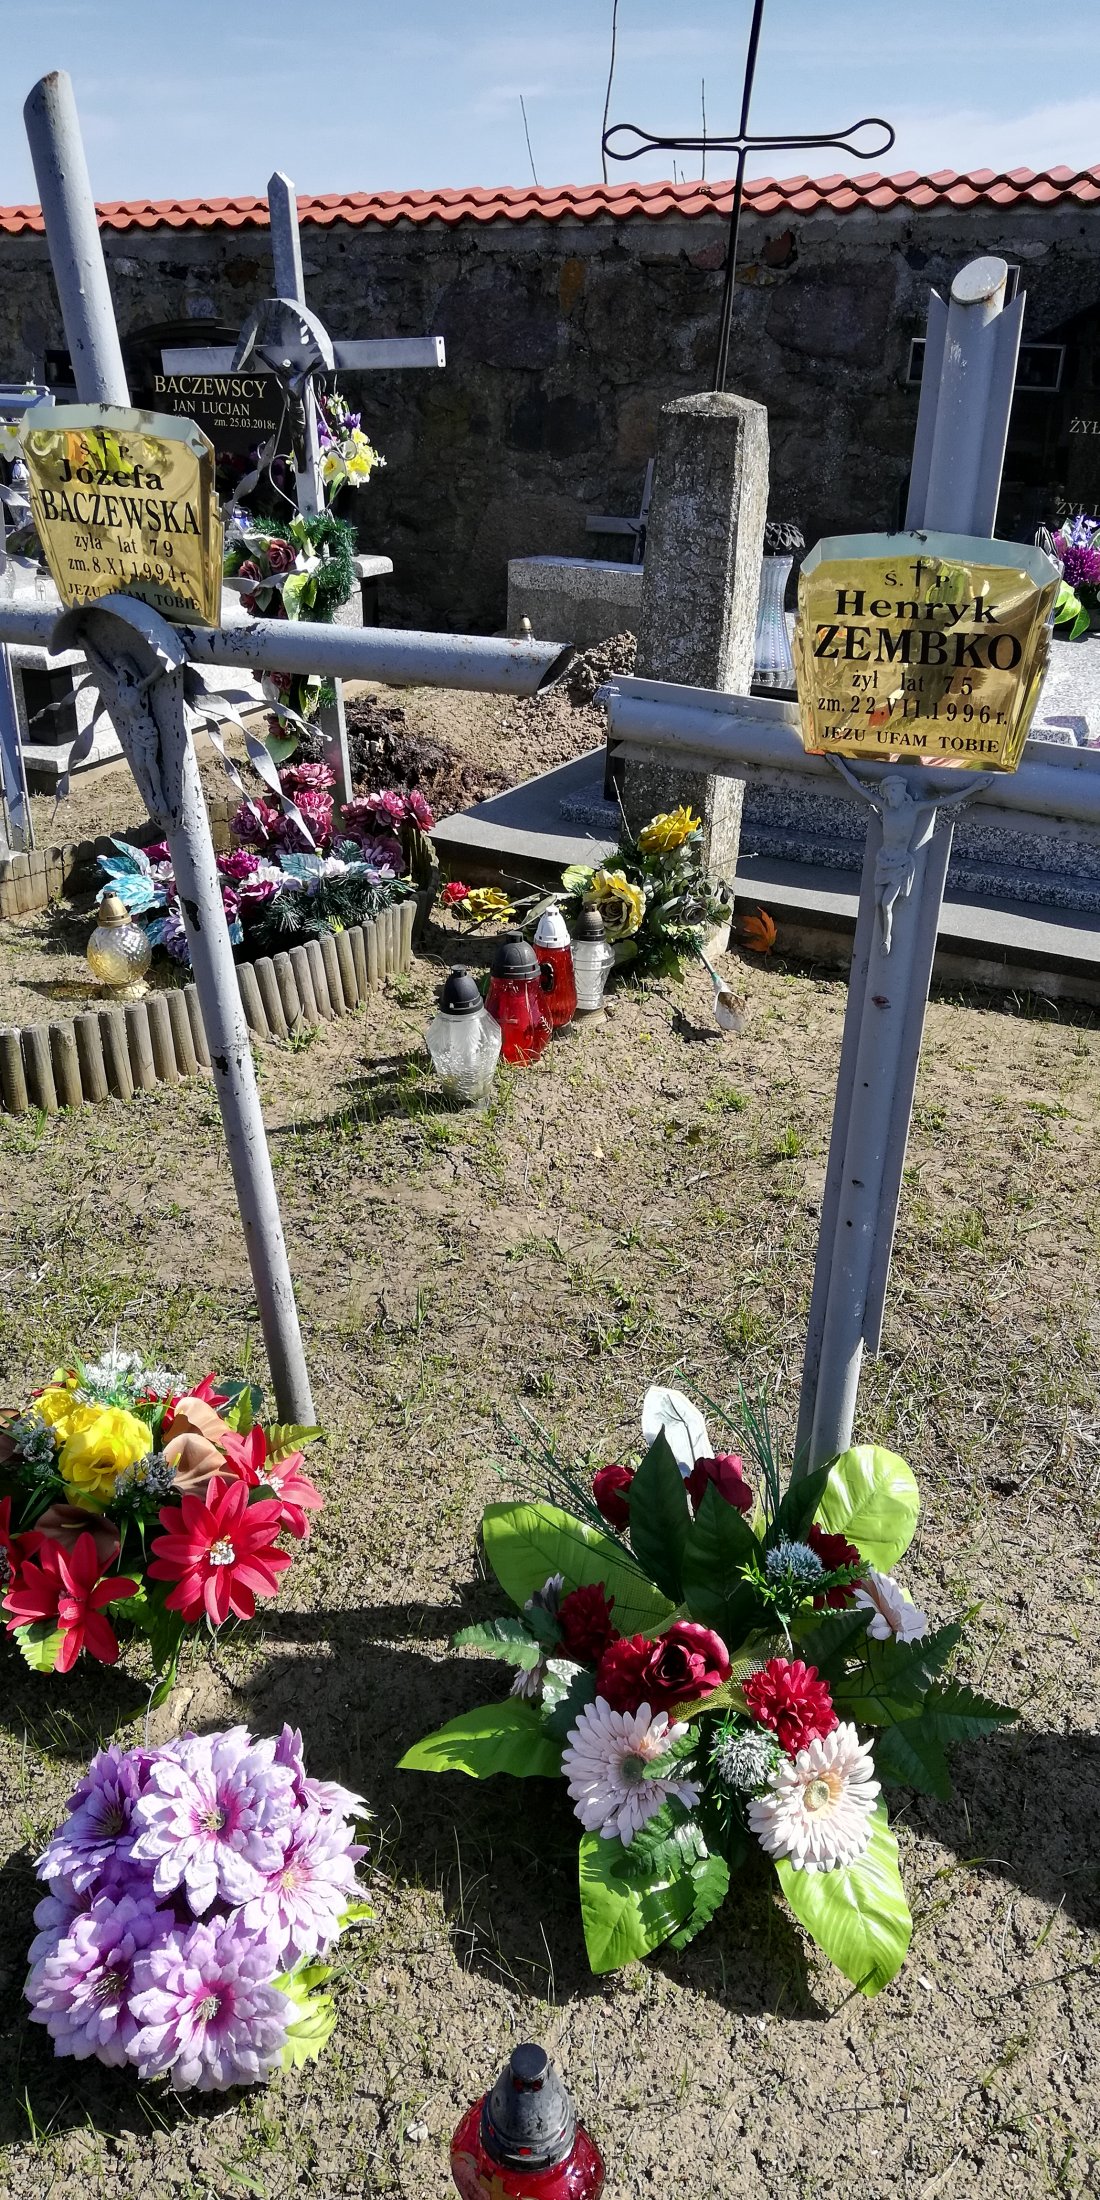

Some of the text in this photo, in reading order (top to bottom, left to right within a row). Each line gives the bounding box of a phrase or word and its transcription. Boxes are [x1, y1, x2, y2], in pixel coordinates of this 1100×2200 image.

[154, 375, 267, 399] BACZEWSCY
[173, 400, 250, 417] JAN LUCJAN
[214, 419, 228, 427] zm.
[60, 458, 164, 491] Józefa
[39, 488, 202, 536] BACZEWSKA
[117, 535, 138, 554] lat
[149, 539, 174, 558] 79
[68, 558, 90, 572] zm.
[936, 575, 953, 589] P.
[68, 582, 101, 598] JEZU
[154, 593, 201, 611] TOBIE
[834, 589, 1000, 628] Henryk
[814, 624, 1022, 671] ZEMBKO
[852, 669, 973, 696] żył lat 75
[818, 697, 845, 713] zm.
[822, 726, 999, 753] JEZU UFAM TOBIE
